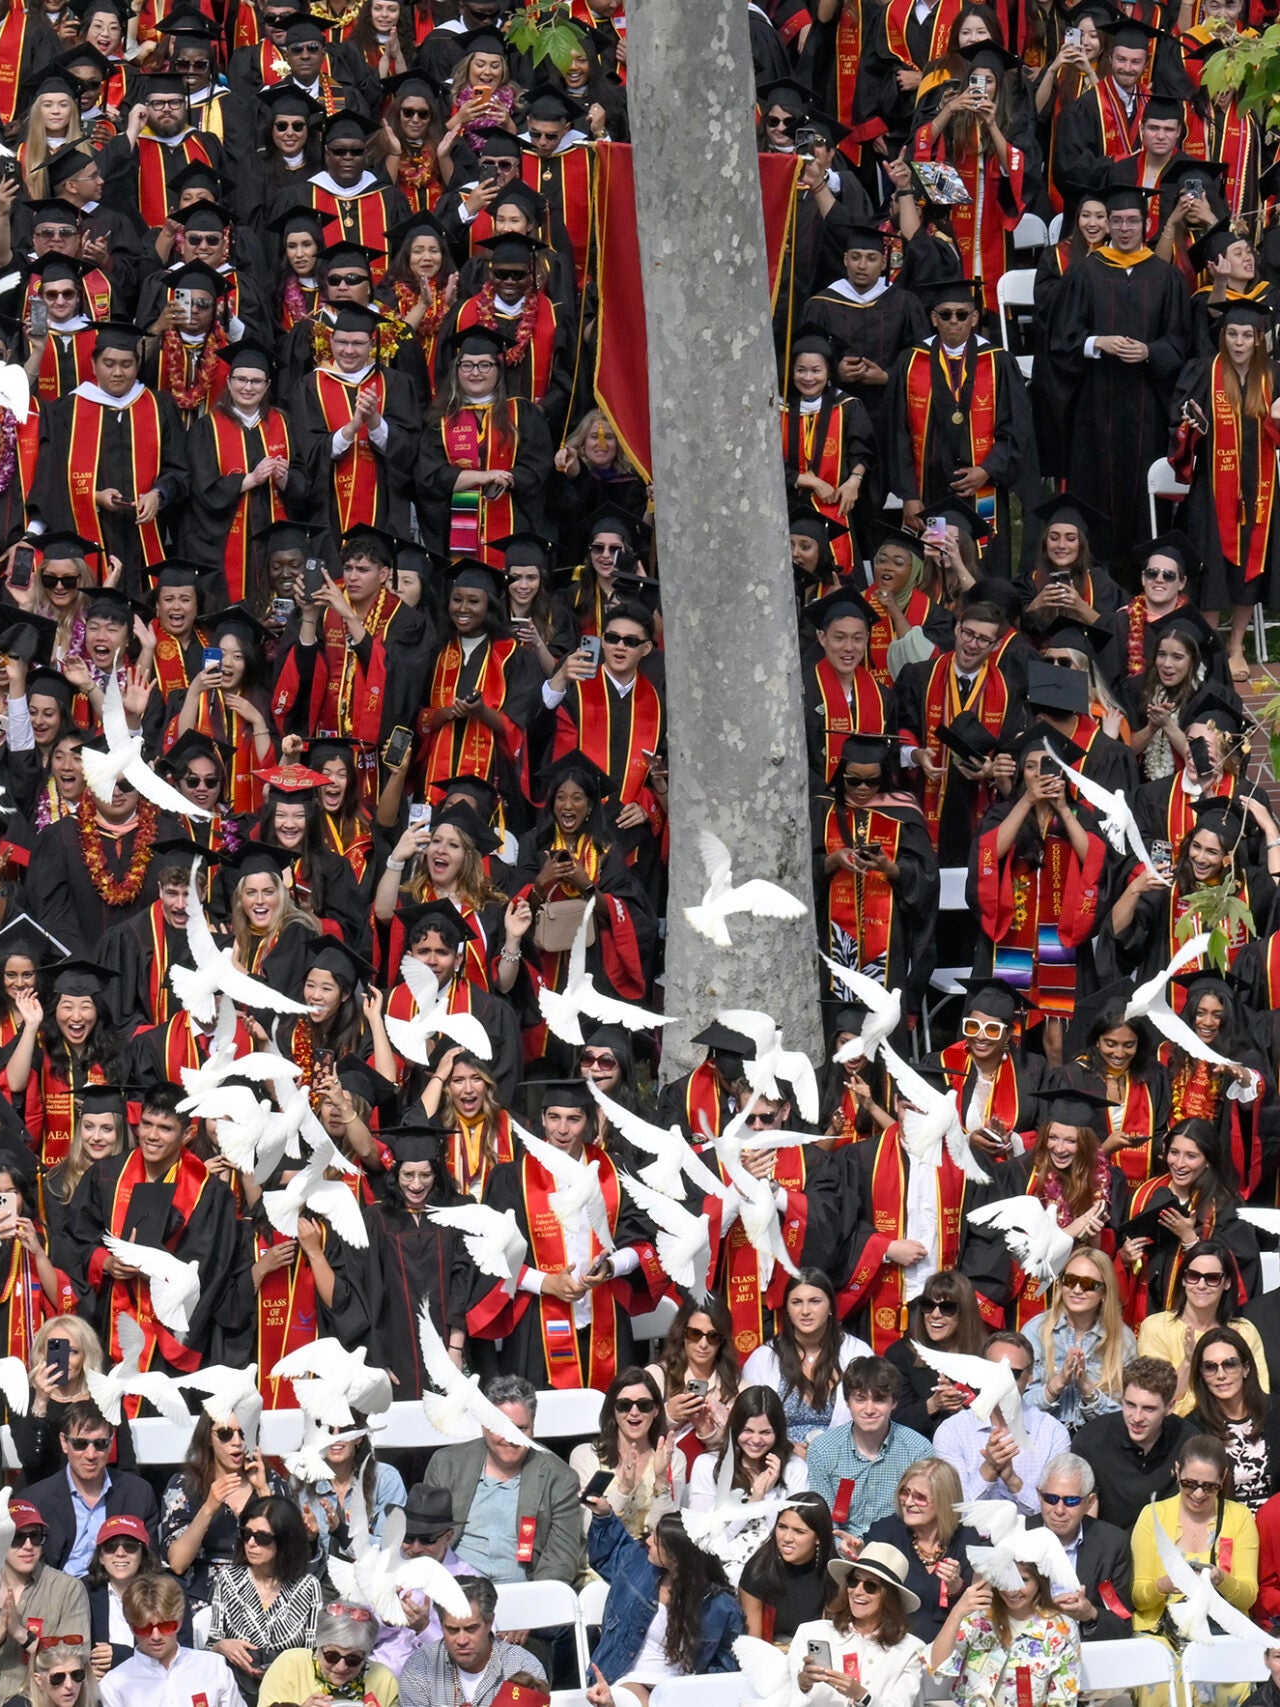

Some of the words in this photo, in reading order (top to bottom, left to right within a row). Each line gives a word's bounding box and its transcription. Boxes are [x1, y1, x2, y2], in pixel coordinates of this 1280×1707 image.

[839, 54, 858, 62] CLASS
[959, 204, 969, 212] OF
[452, 425, 473, 433] CLASS
[458, 434, 467, 442] OF
[72, 472, 93, 480] CLASS
[77, 479, 87, 487] OF
[367, 694, 379, 712] USC
[983, 847, 992, 867] USC
[1052, 843, 1061, 889] CONGRATS
[1052, 891, 1061, 916] GRAD
[1080, 896, 1092, 914] USC
[875, 1210, 889, 1218] USC
[786, 1228, 798, 1248] USC
[540, 1262, 563, 1271] CLASS
[731, 1275, 757, 1284] CLASS
[854, 1266, 871, 1285] USC
[738, 1284, 750, 1293] OF
[735, 1294, 755, 1303] 2023
[262, 1299, 287, 1308] CLASS
[269, 1308, 281, 1316] OF
[265, 1317, 284, 1326] 2023
